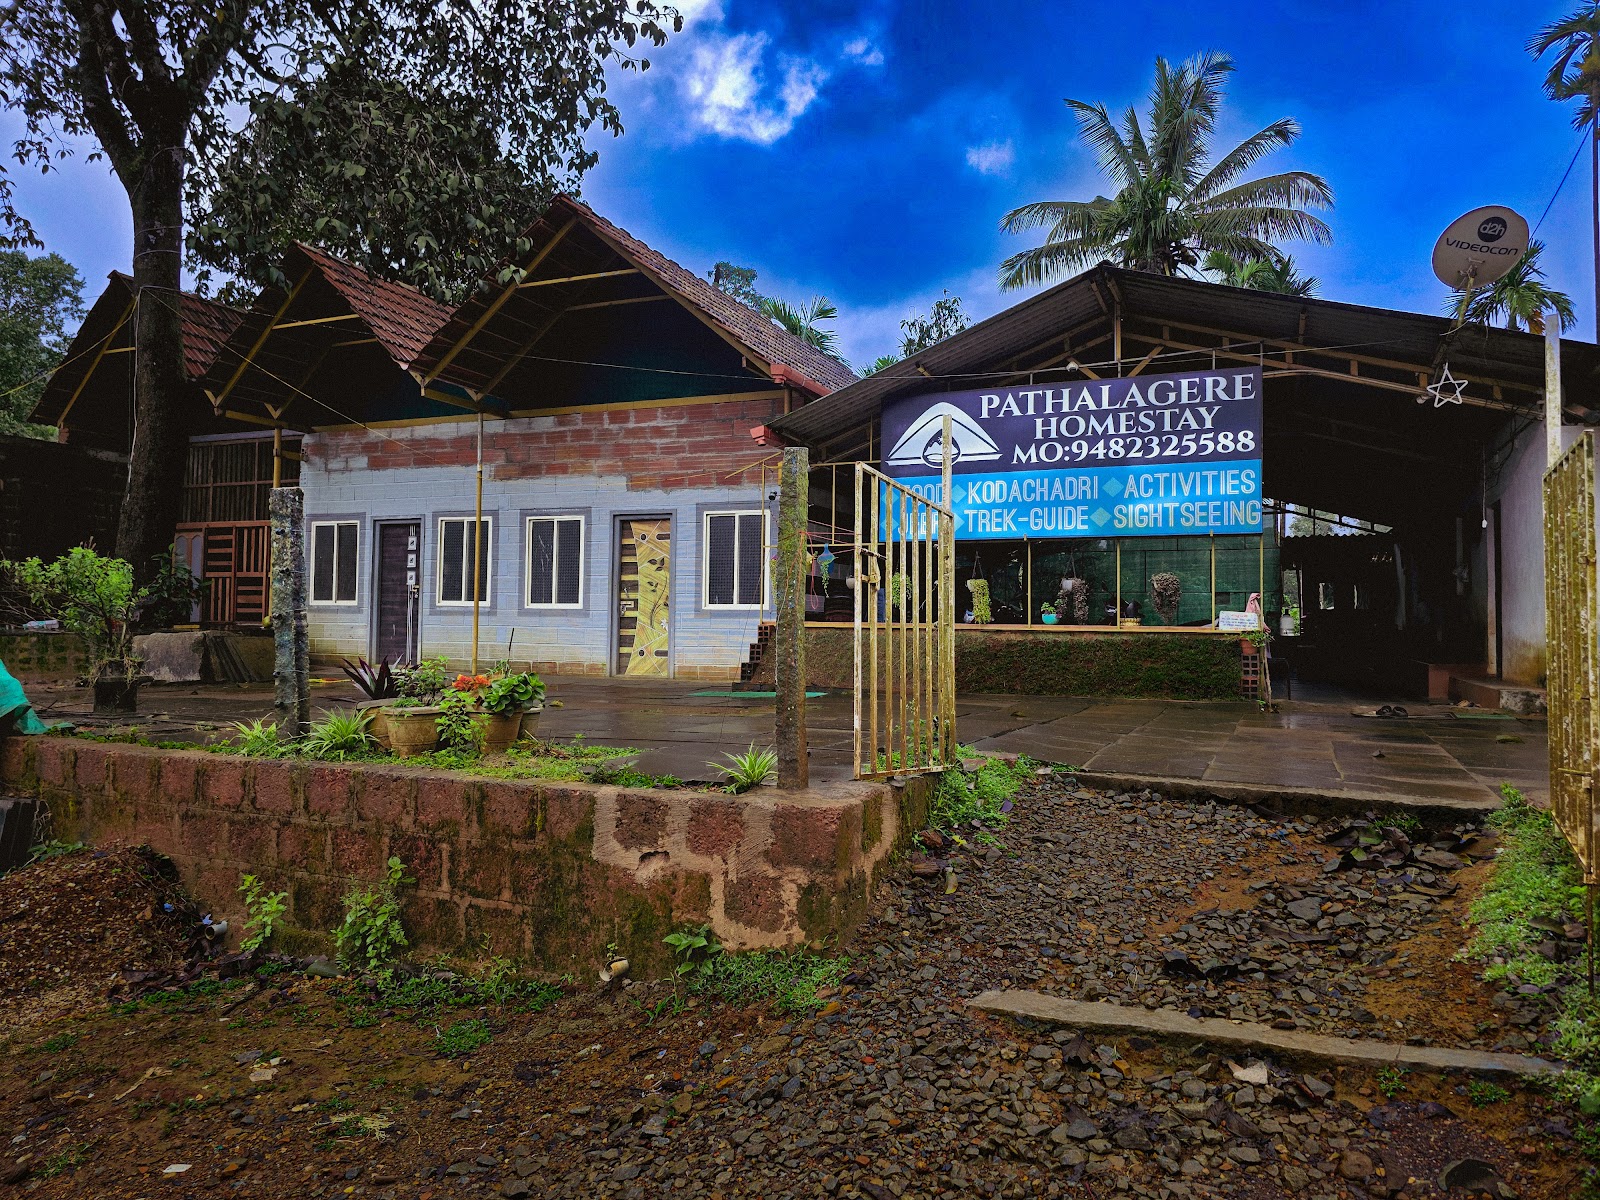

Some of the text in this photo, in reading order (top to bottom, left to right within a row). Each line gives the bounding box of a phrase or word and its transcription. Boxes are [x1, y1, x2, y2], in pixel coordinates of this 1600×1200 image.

[1446, 237, 1518, 255] VIDEOCON
[1480, 222, 1505, 236] d2h
[979, 373, 1256, 419] PATHALAGERE
[1034, 405, 1222, 440] HOMESTAY
[1011, 430, 1255, 464] MO:9482325588
[967, 476, 1098, 505] KODACHADRI
[1123, 469, 1256, 499] ACTIVITIES
[963, 505, 1089, 533] TREK-GUIDE
[1113, 500, 1261, 529] SIGHTSEEING
